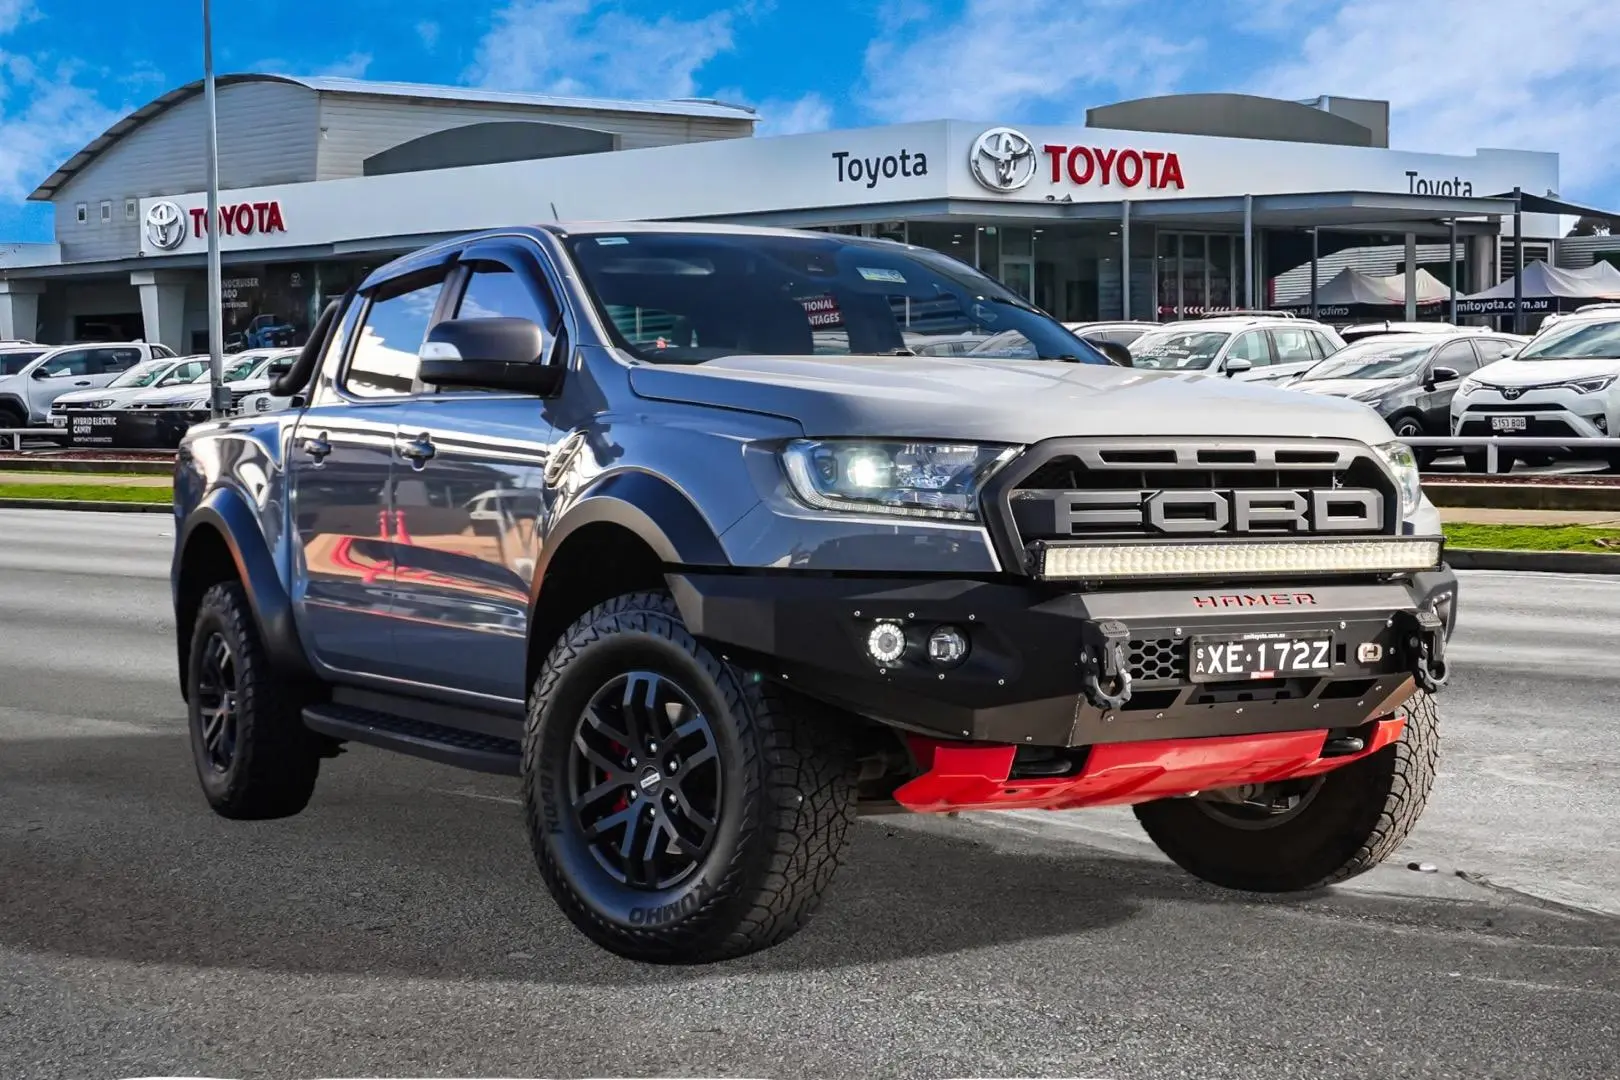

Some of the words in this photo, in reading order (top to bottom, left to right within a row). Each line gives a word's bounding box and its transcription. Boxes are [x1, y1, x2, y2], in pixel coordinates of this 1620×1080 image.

[832, 148, 928, 189] Toyota
[1044, 144, 1184, 190] TOYOTA
[93, 417, 117, 425] ELECTRIC
[1054, 489, 1384, 535] FORD
[1193, 593, 1317, 608] HAMER
